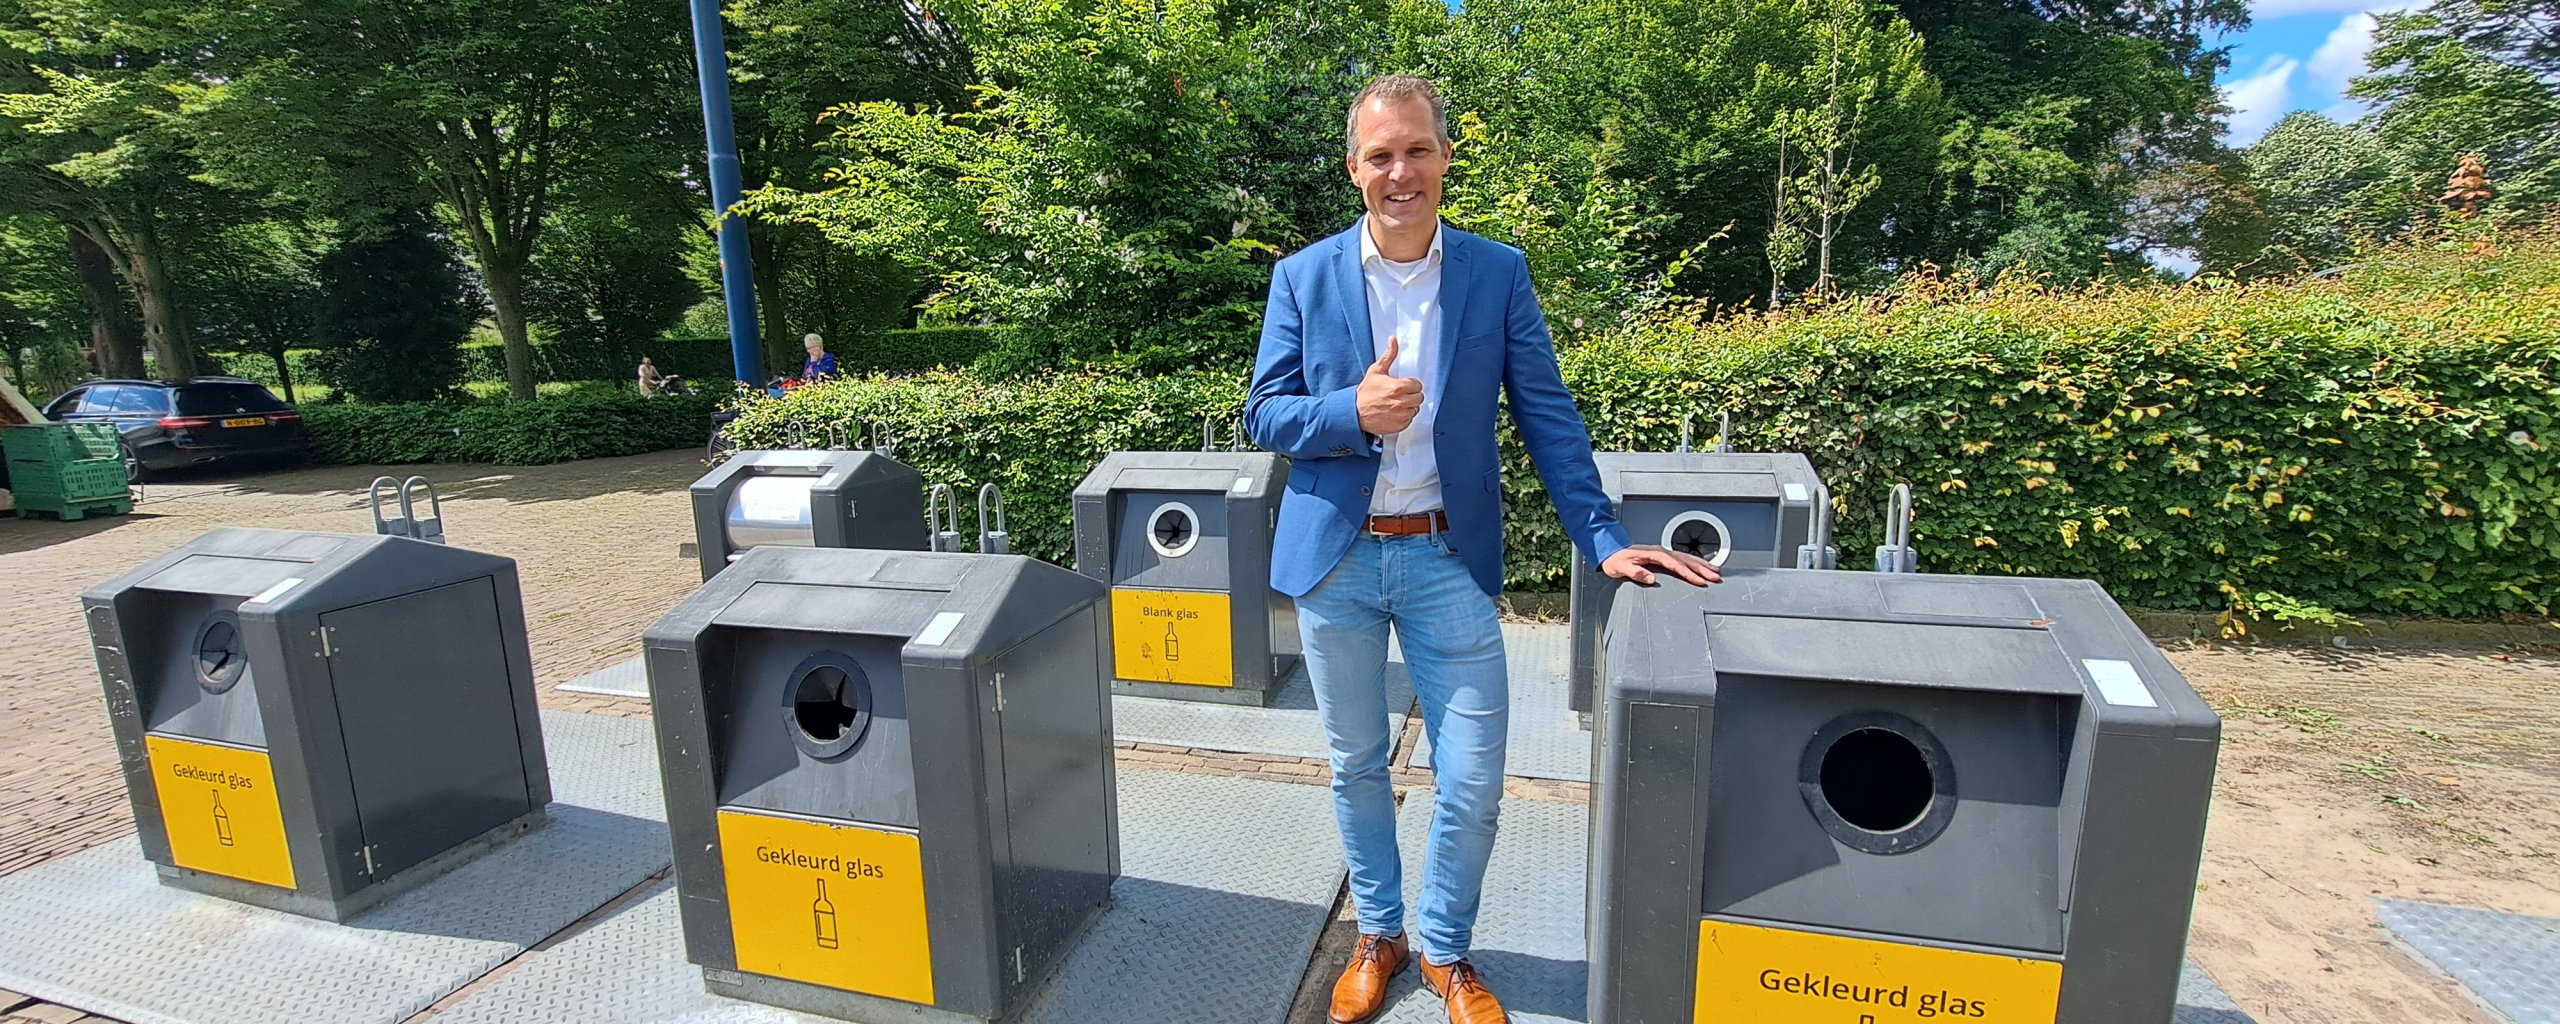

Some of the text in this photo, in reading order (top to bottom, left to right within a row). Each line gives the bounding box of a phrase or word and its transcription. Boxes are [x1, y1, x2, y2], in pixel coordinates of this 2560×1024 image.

[1142, 606, 1199, 621] Blank glas
[173, 763, 253, 790] Gekleurd glas
[756, 846, 884, 880] Gekleurd glas
[1759, 968, 1986, 1018] Gekleurd glas
